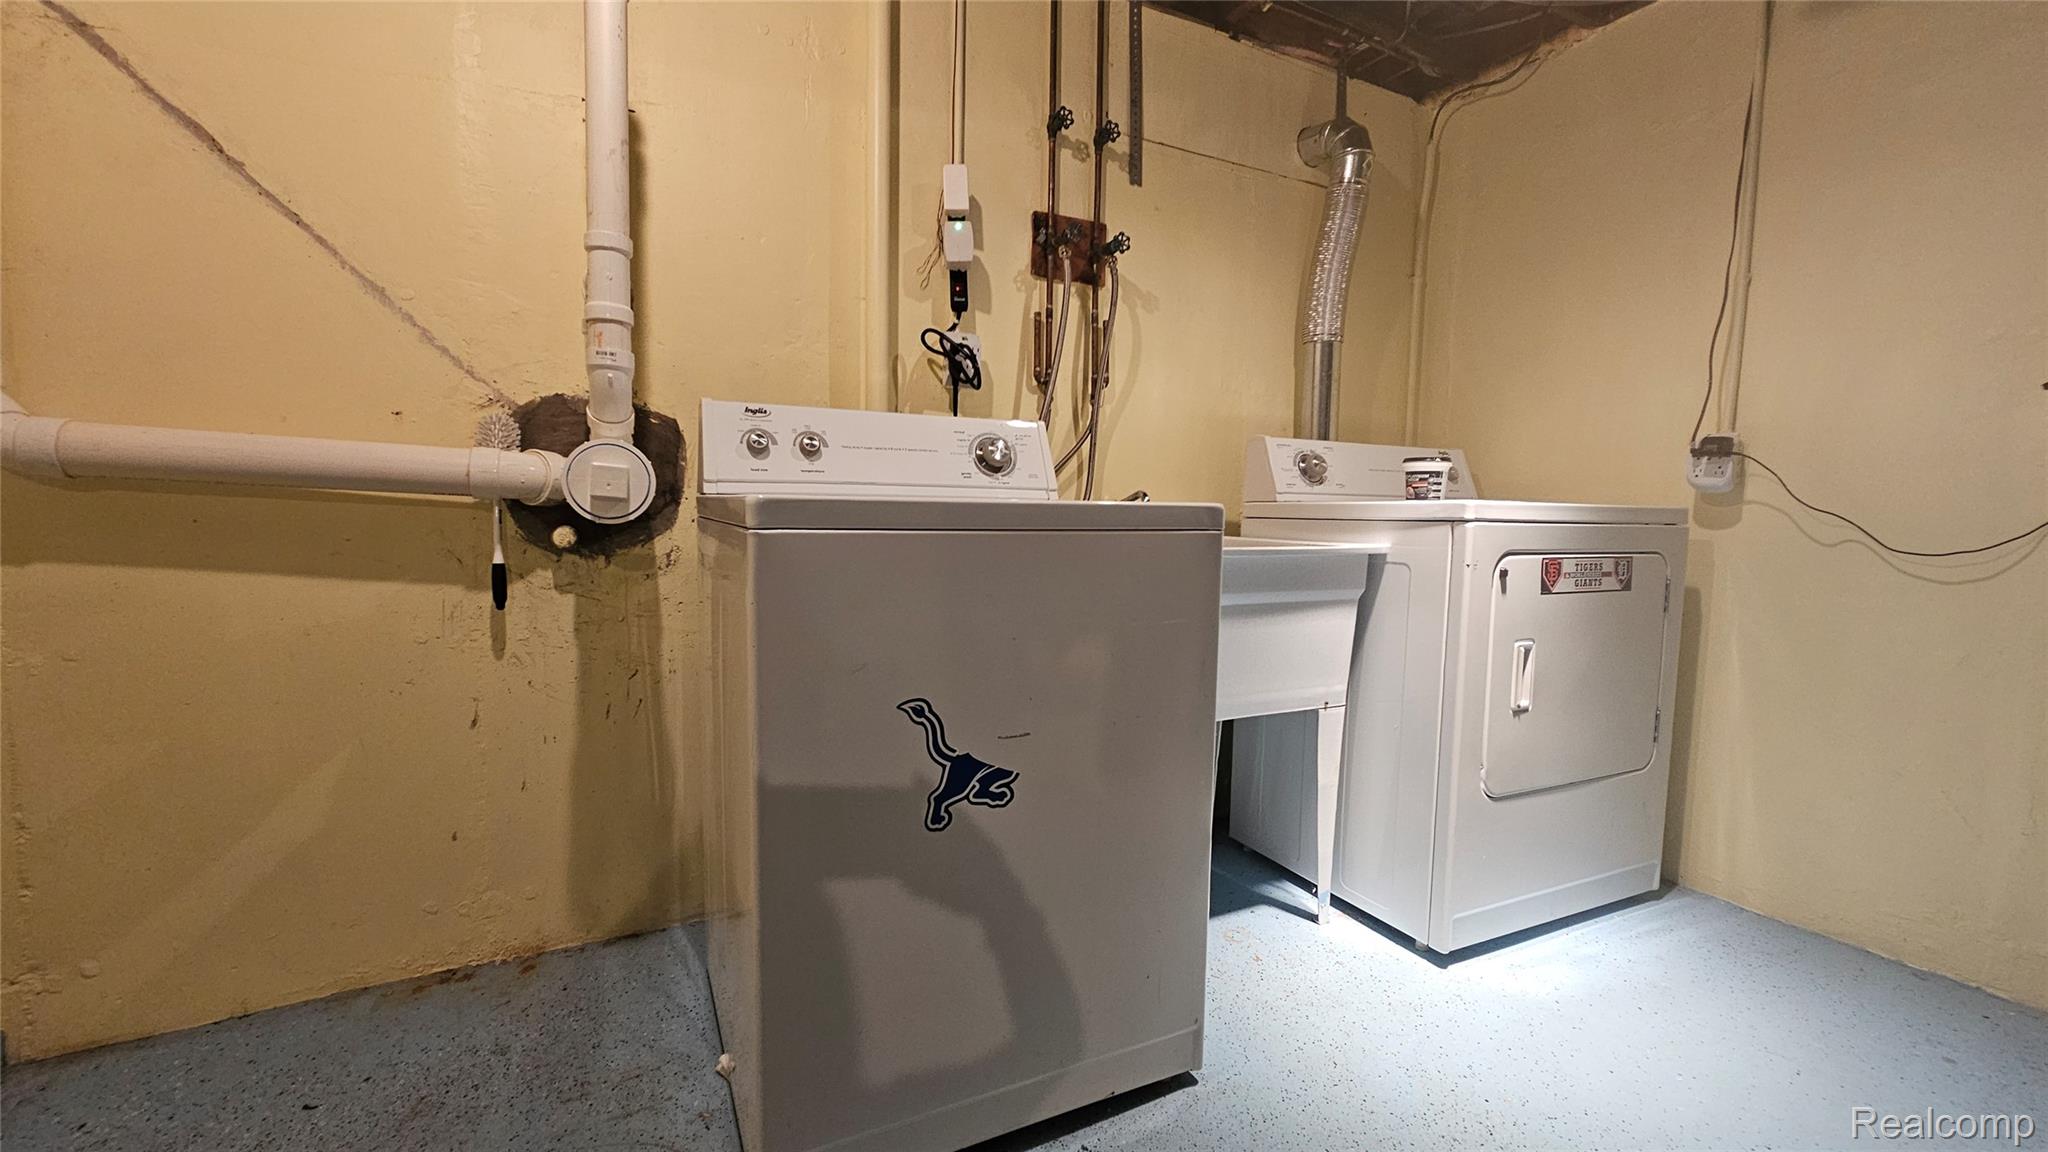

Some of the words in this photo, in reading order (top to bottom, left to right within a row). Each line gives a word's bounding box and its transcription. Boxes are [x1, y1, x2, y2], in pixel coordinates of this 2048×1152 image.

[744, 406, 767, 415] Inglis
[1575, 562, 1603, 571] TIGERS
[1574, 578, 1603, 587] GIANTS
